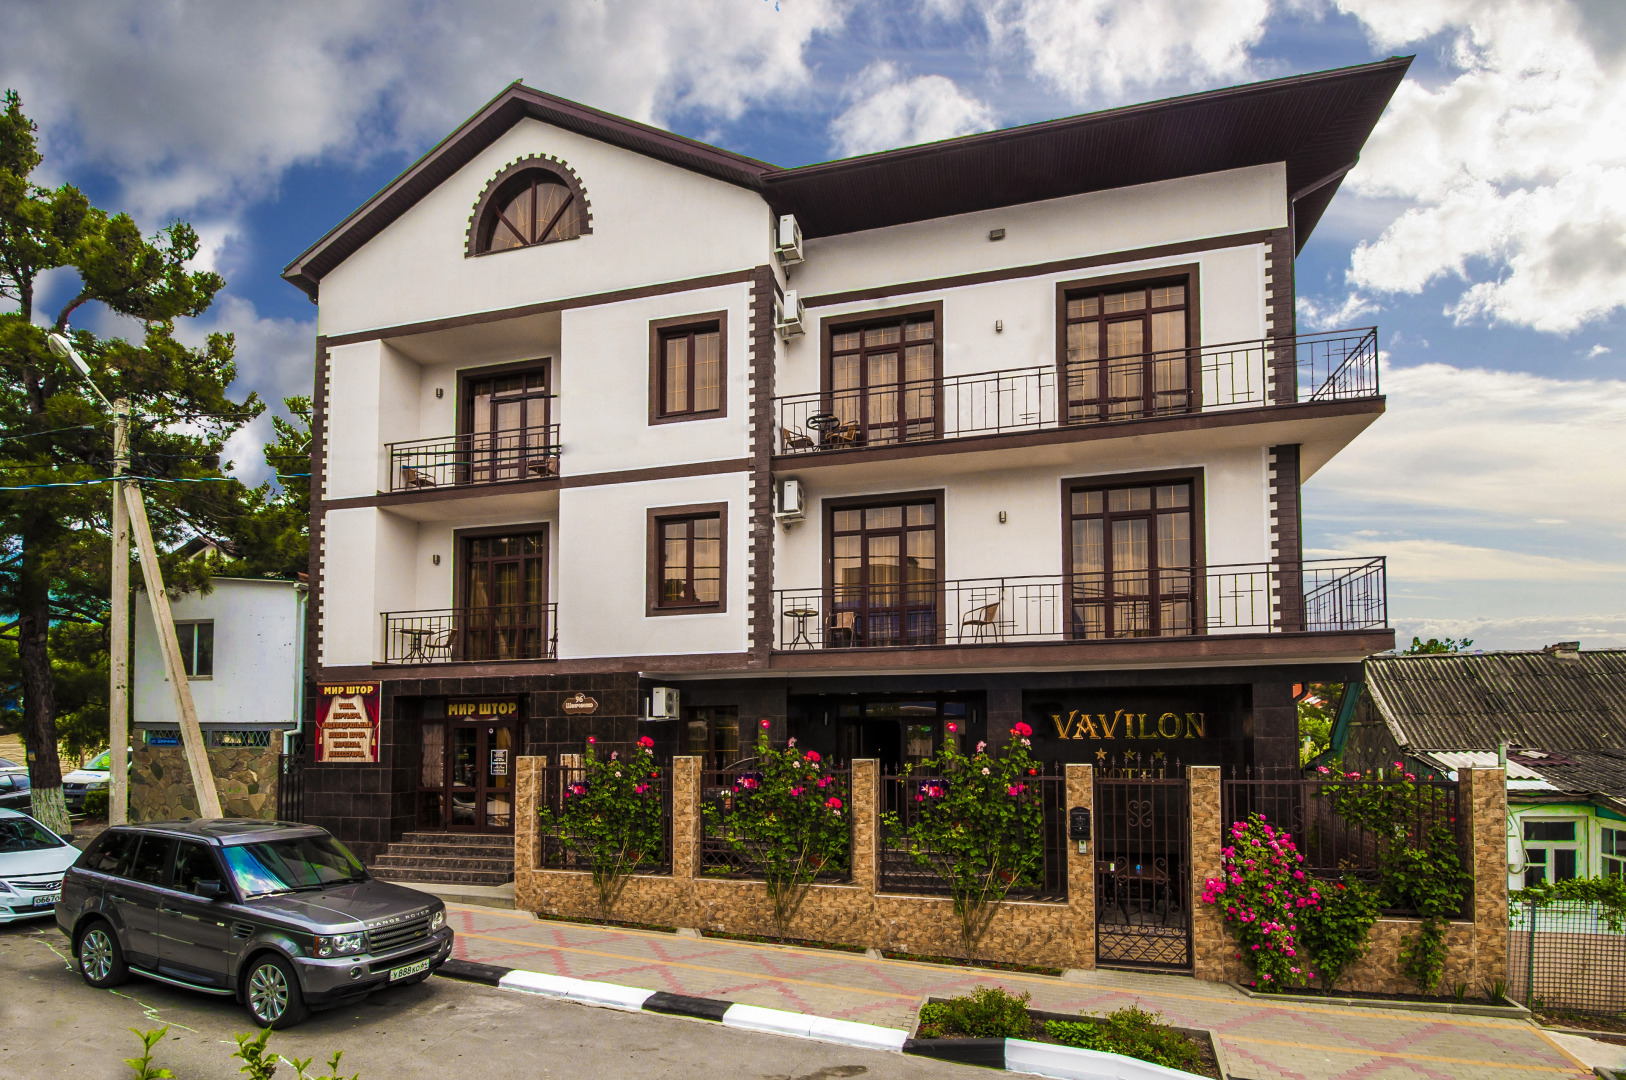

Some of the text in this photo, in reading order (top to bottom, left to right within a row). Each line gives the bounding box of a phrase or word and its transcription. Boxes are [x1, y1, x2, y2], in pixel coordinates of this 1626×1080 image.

[324, 686, 373, 695] МИР ШТОР
[448, 703, 517, 715] МИР ШТОР
[1051, 709, 1205, 739] VAVILON
[368, 909, 430, 927] RANGE ROVER
